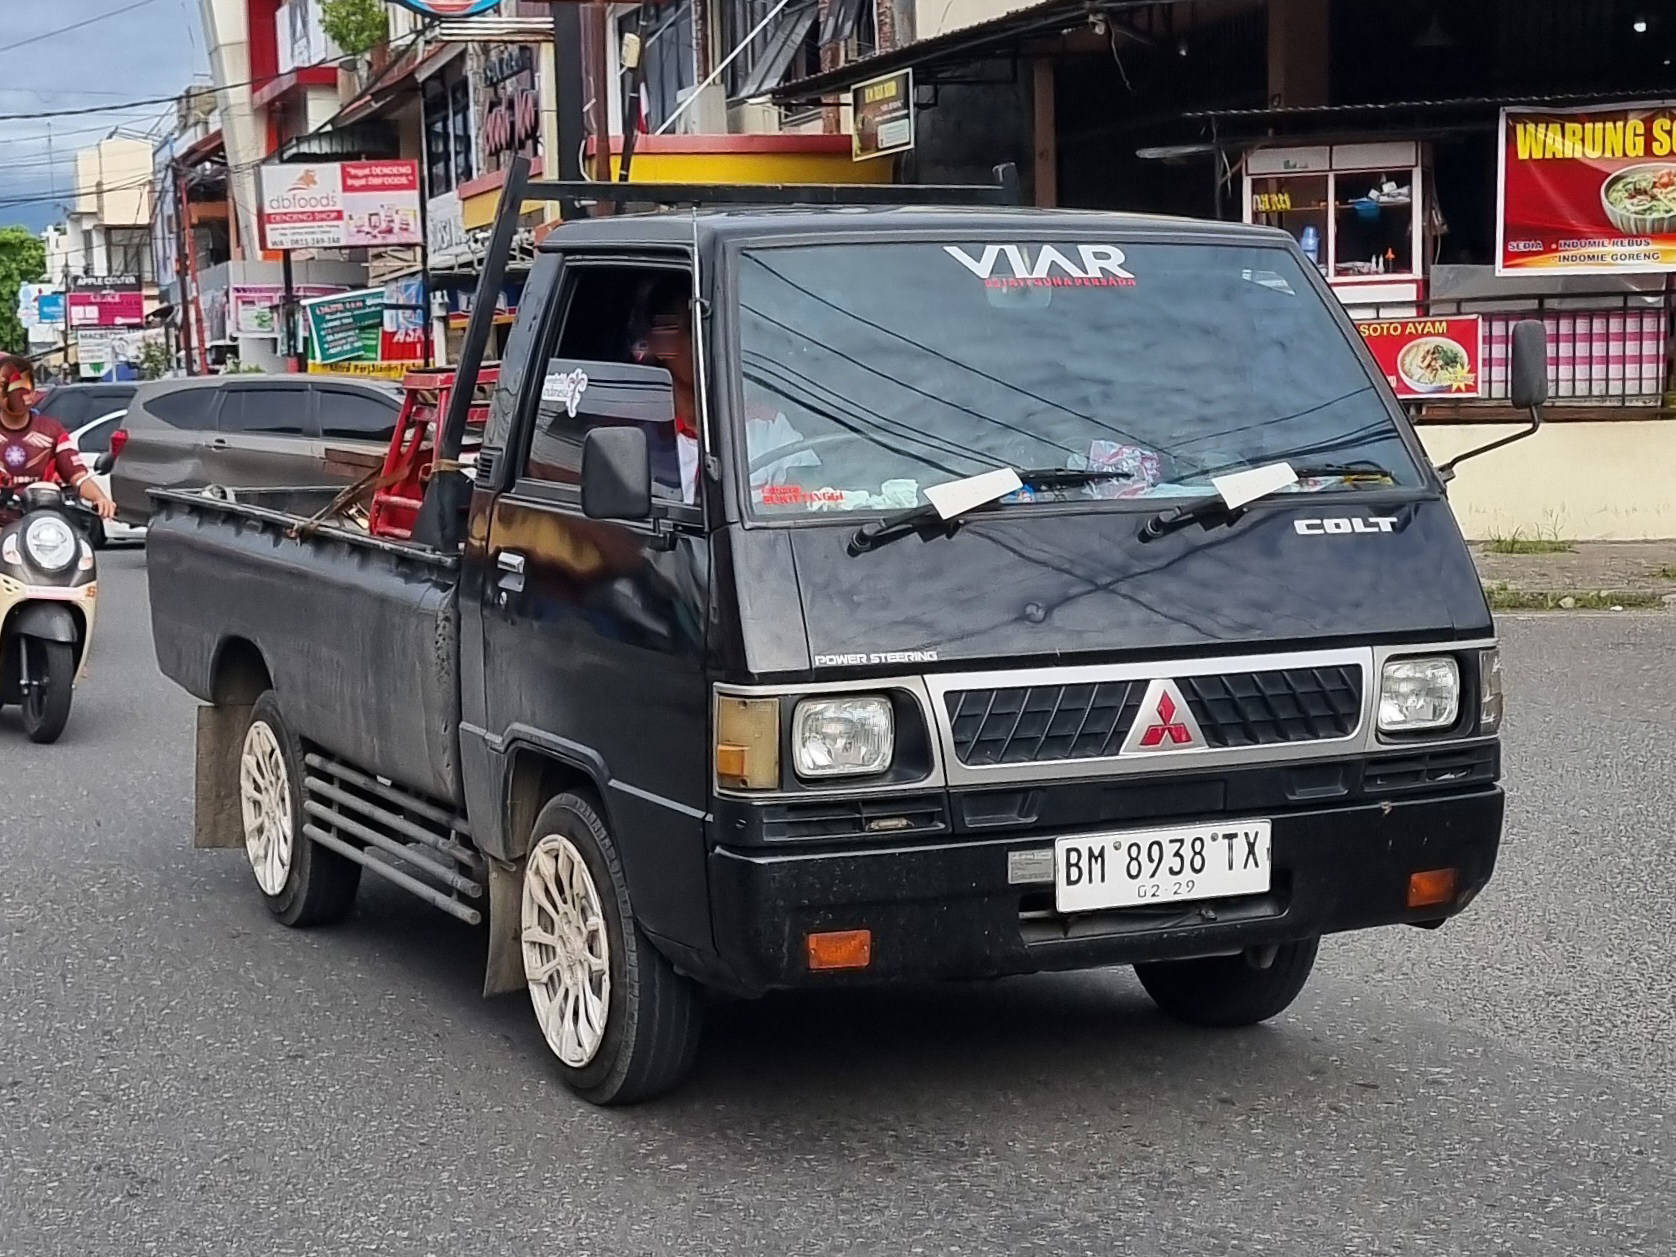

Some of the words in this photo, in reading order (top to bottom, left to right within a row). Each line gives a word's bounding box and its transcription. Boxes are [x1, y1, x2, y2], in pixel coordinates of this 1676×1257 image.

[1516, 119, 1645, 160] WARUNG
[1652, 117, 1676, 158] S
[269, 193, 337, 210] dbfoods
[1508, 241, 1543, 251] SEDIA
[1558, 239, 1608, 251] INDOMIE
[1612, 238, 1651, 248] REBUS
[943, 244, 1135, 279] VIAR
[1558, 254, 1607, 263] INDOMIE
[1610, 252, 1660, 262] GORENG
[76, 276, 102, 286] APPLE
[1360, 323, 1402, 337] SOTO
[1405, 321, 1447, 335] AYAM
[1294, 516, 1398, 535] COLT
[814, 653, 868, 666] POWER
[869, 650, 938, 664] STEERING
[1065, 844, 1106, 886] BM
[1125, 836, 1206, 880] 8938
[1222, 830, 1260, 871] TX
